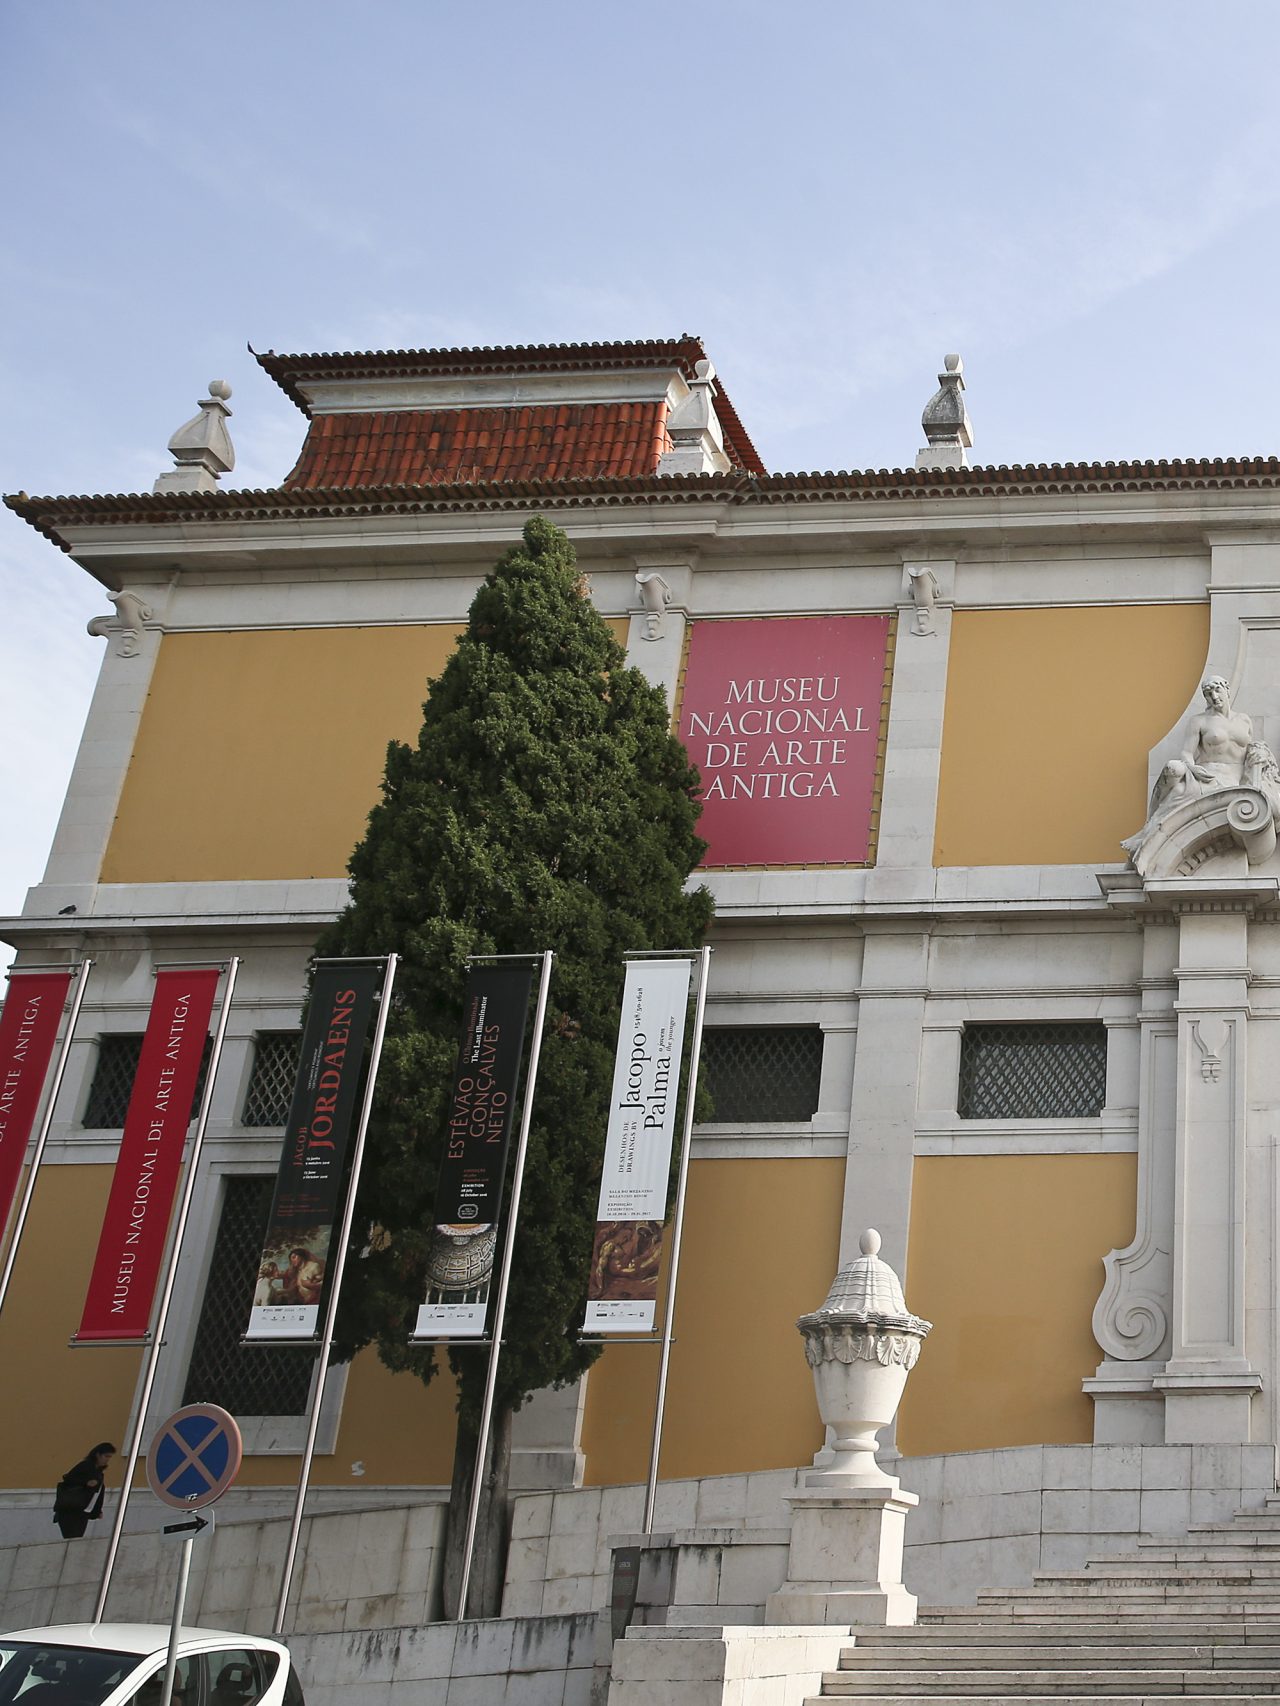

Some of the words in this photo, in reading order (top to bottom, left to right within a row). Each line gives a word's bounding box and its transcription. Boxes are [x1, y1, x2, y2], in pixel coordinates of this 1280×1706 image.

[724, 676, 841, 704] MUSEU
[688, 707, 870, 737] NACIONAL
[704, 742, 749, 769] DE
[758, 739, 847, 767] ARTE
[702, 771, 840, 801] ANTIGA
[165, 993, 191, 1061] ANTIGA
[475, 996, 488, 1033] Illuminator
[667, 1016, 675, 1041] younger
[0, 1069, 22, 1115] ARTE
[12, 995, 42, 1062] ANTIGA
[471, 1048, 480, 1064] The
[473, 1033, 482, 1049] Last
[665, 1041, 673, 1052] the
[154, 1067, 175, 1112] ARTE
[308, 989, 357, 1150] JORDAENS
[469, 1024, 500, 1138] GONÇALVES
[619, 1032, 652, 1115] Jacopo
[644, 1055, 671, 1131] Palma
[148, 1119, 165, 1141] DE
[448, 1077, 474, 1159] ESTÊVÃO
[486, 1091, 508, 1144] NETO
[293, 1126, 308, 1167] JACOB
[618, 1132, 628, 1173] DESENHOS
[624, 1121, 630, 1131] DE
[626, 1131, 636, 1173] DRAWINGS
[631, 1121, 638, 1131] BY
[125, 1148, 158, 1245] NACIONAL
[111, 1252, 136, 1314] MUSEU
